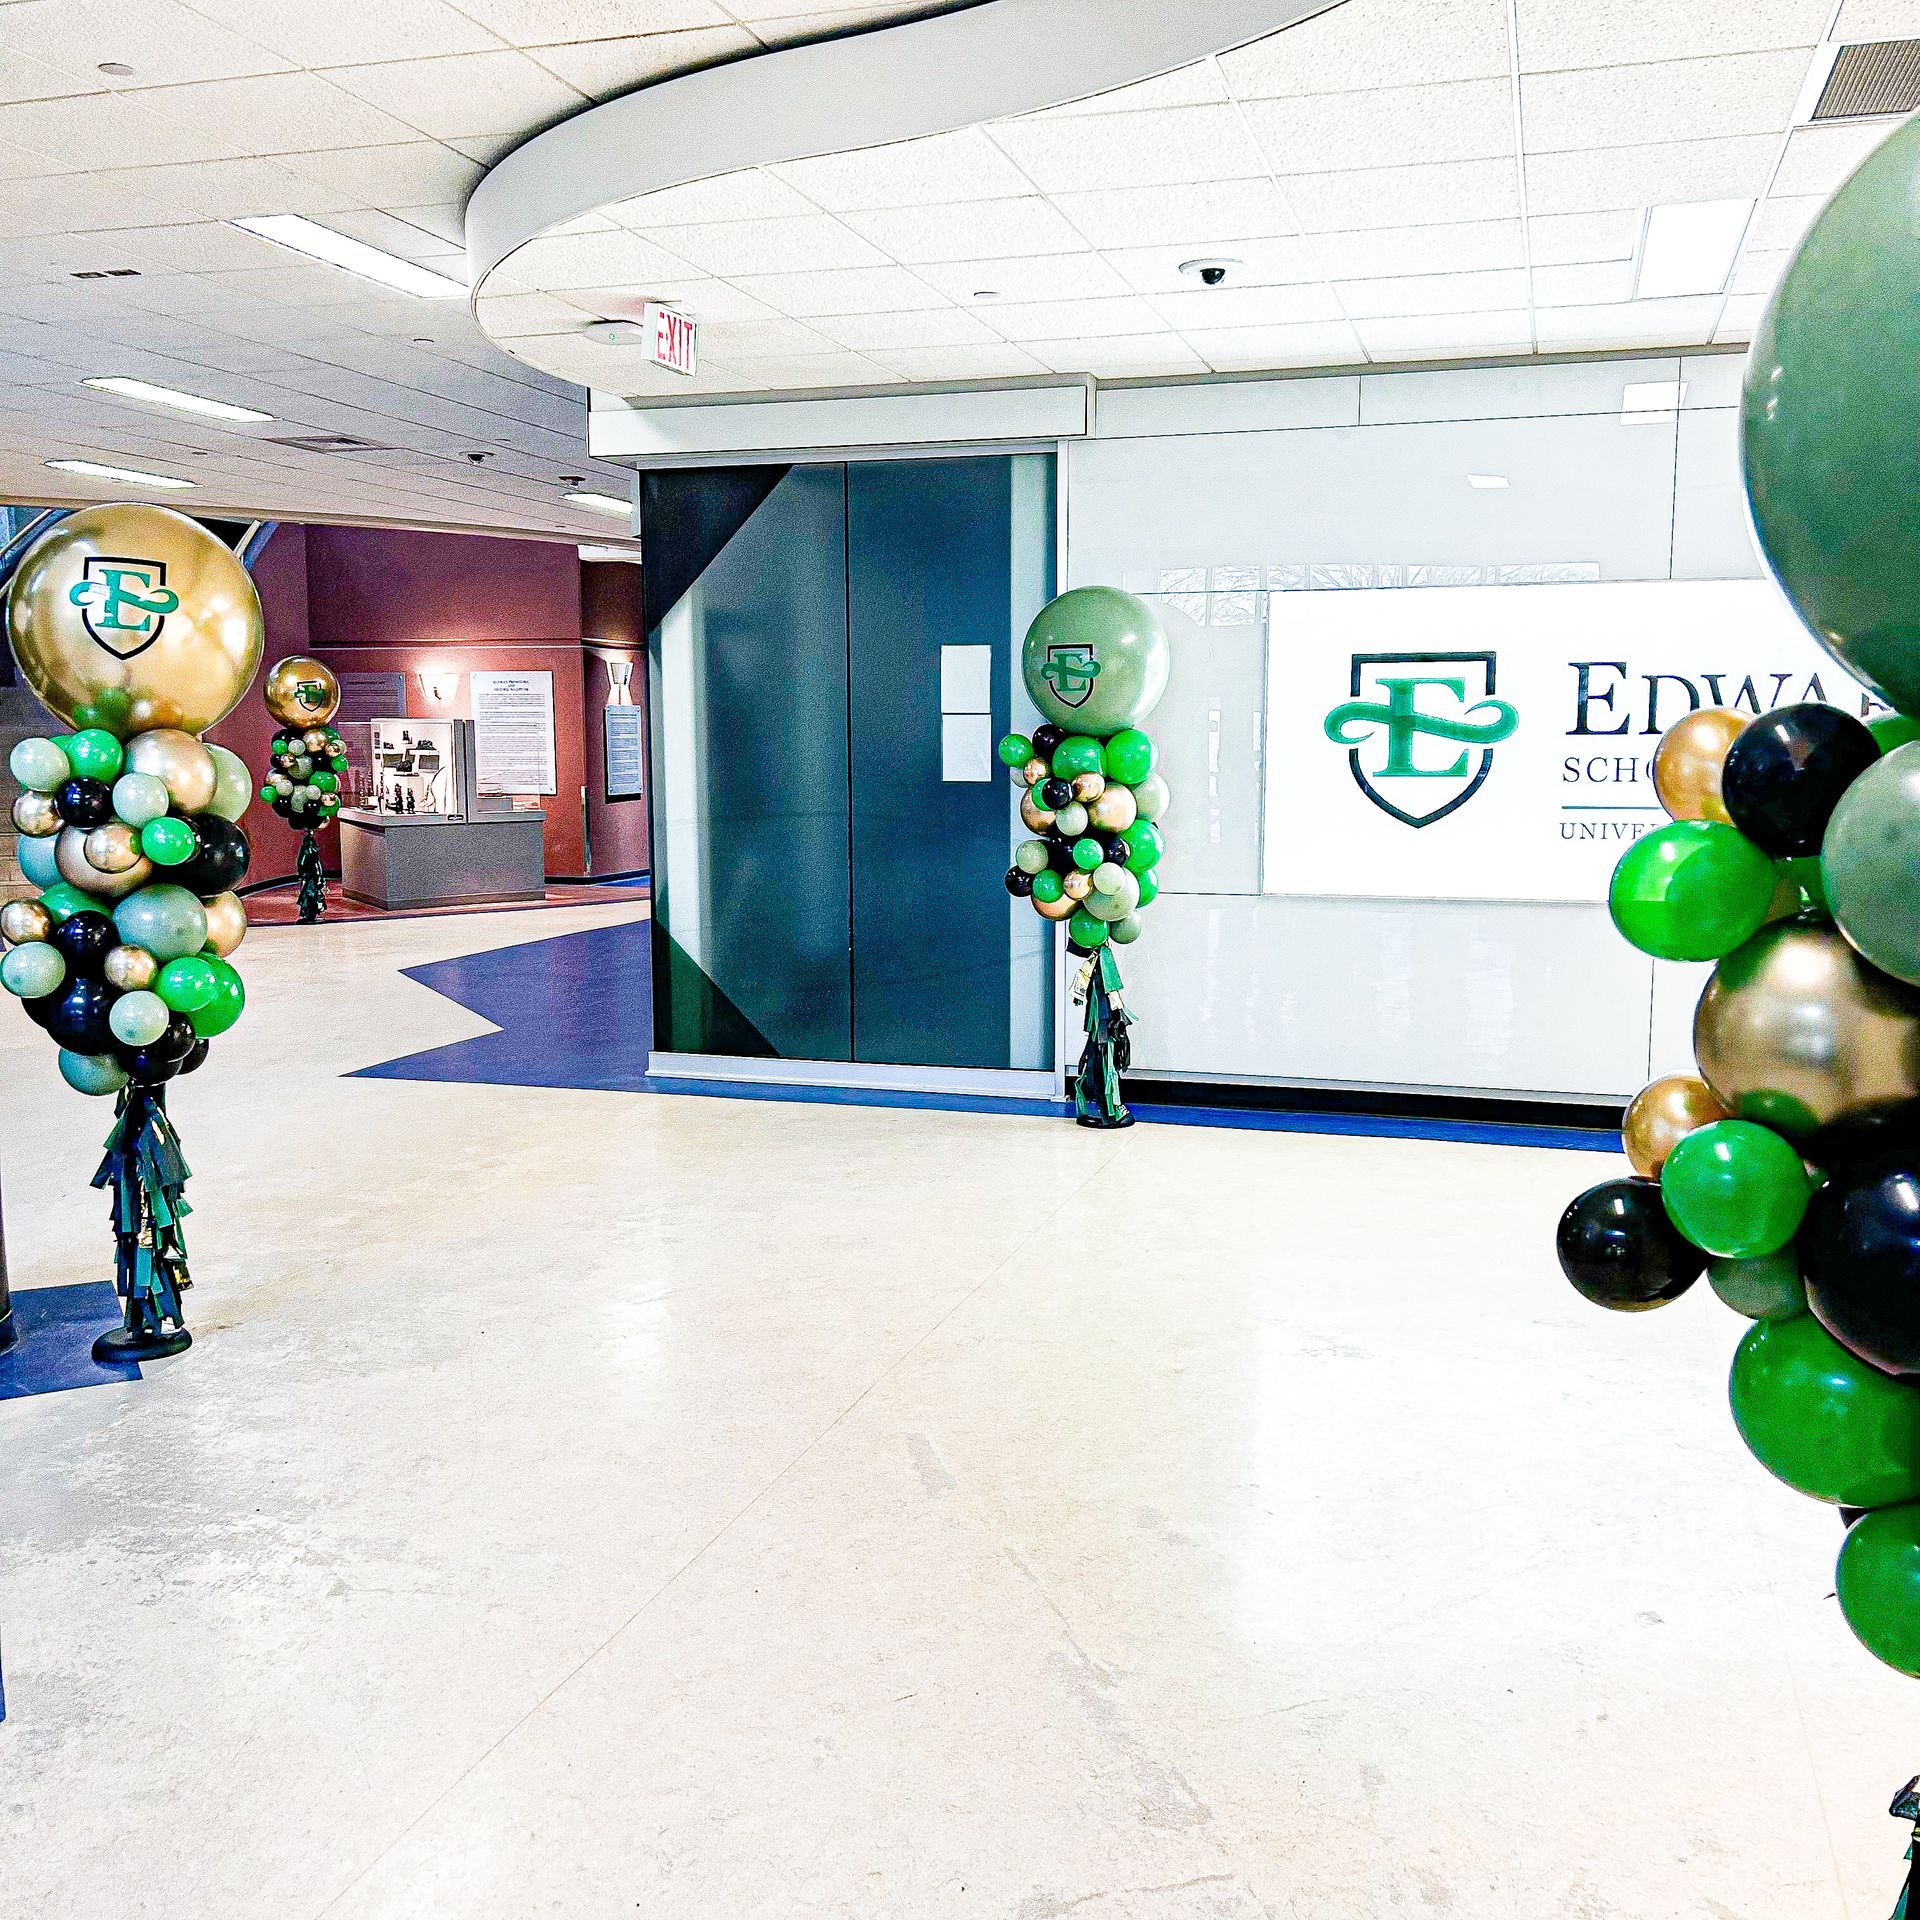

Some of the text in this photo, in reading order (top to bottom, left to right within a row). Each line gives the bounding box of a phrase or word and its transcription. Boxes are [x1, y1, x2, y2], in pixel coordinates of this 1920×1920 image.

[656, 311, 693, 370] EXIT
[69, 568, 180, 632] E
[1324, 677, 1520, 777] E
[1559, 822, 1661, 840] UNIVE
